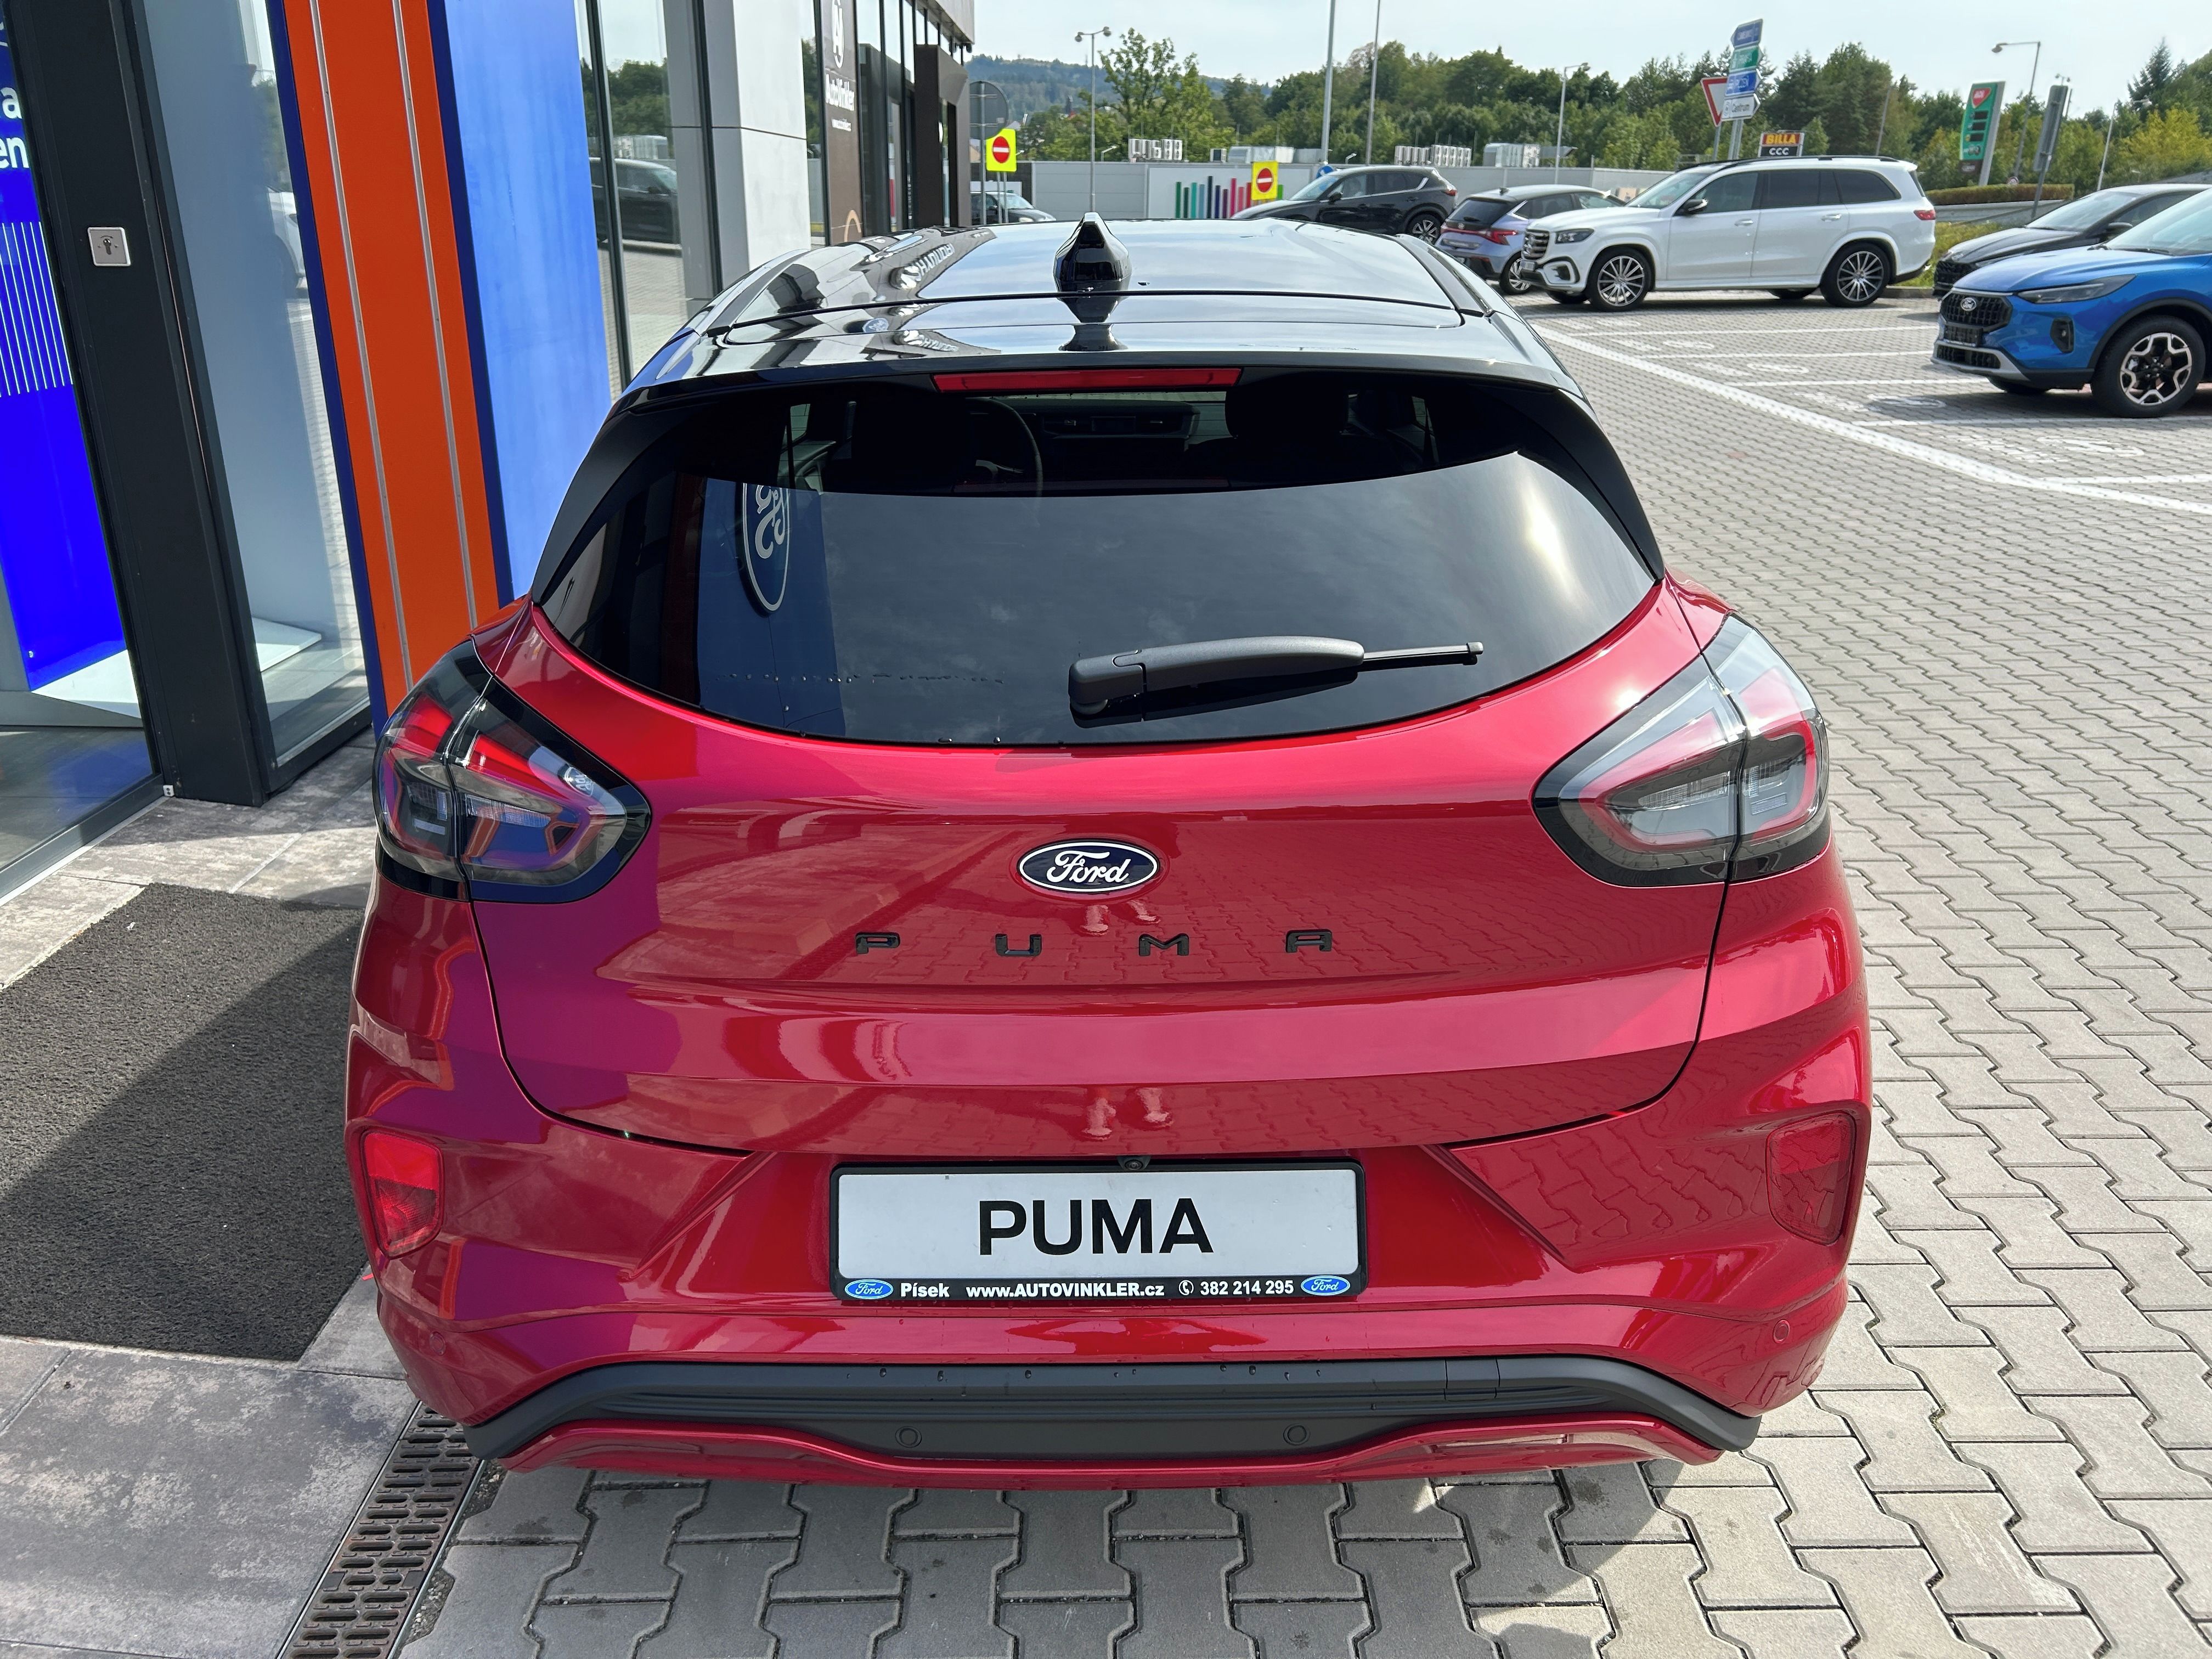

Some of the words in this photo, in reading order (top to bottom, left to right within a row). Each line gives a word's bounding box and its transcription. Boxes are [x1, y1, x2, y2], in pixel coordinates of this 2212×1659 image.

[1766, 134, 1796, 145] BILLA
[1769, 147, 1790, 155] CCC
[1046, 850, 1131, 883] Ford
[855, 928, 1333, 957] PUMA
[979, 1198, 1214, 1255] PUMA
[855, 1282, 884, 1295] Ford
[900, 1282, 950, 1297] Písek
[966, 1282, 1165, 1298] www.AUTOVINKLER.cz
[1200, 1280, 1229, 1296] 382
[1233, 1280, 1261, 1295] 214
[1265, 1279, 1294, 1295] 295
[1311, 1279, 1340, 1291] Ford
